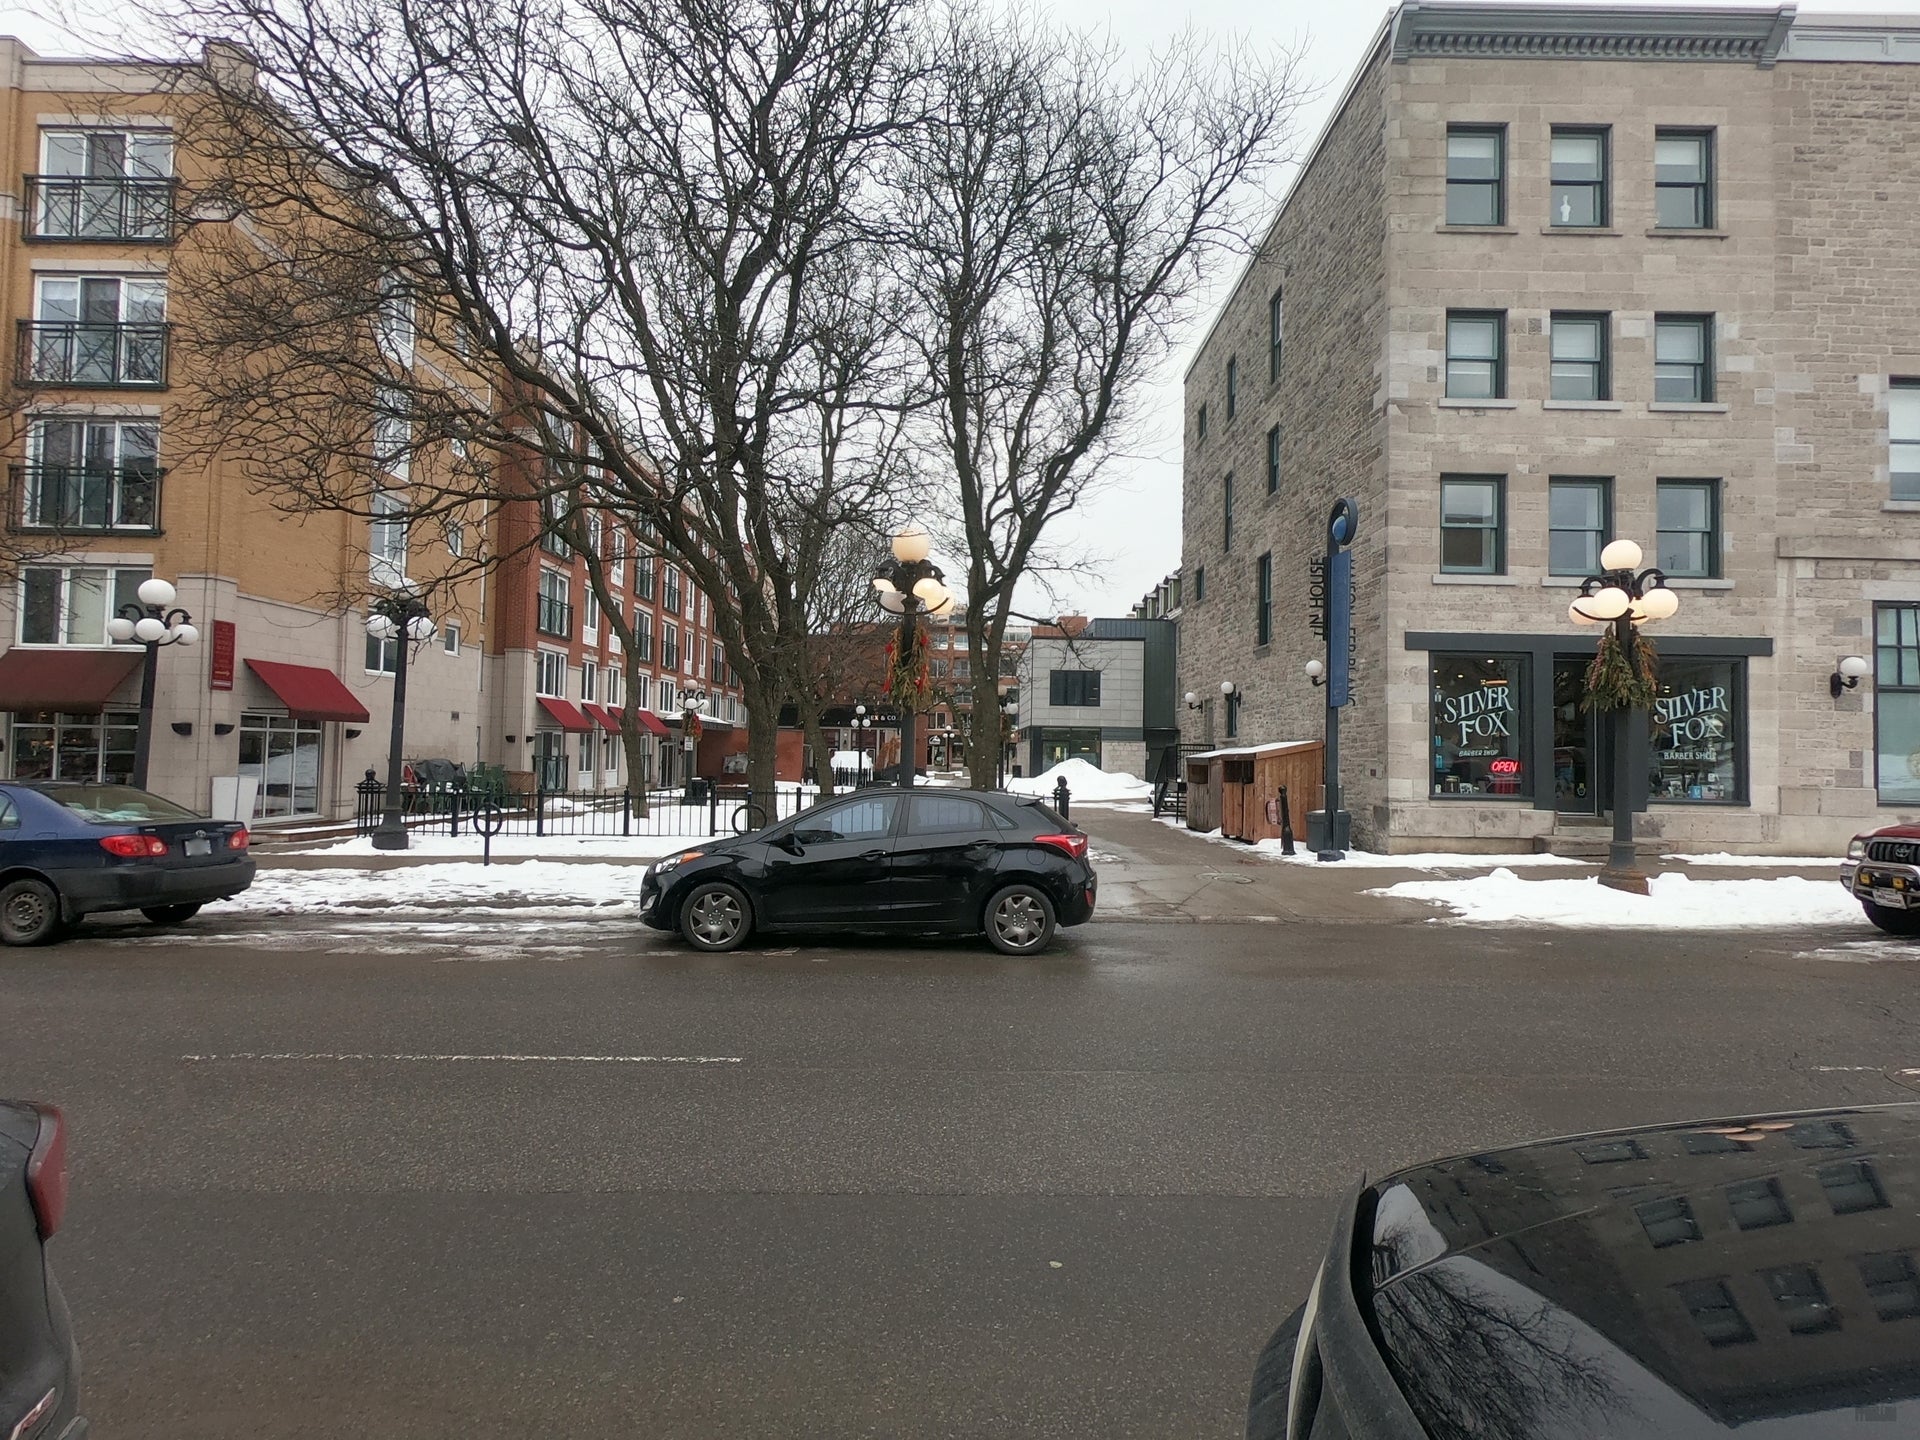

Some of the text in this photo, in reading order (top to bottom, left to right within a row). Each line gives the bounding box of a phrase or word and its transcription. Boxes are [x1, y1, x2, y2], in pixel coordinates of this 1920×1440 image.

[1309, 557, 1325, 608] HOUSE
[1444, 686, 1514, 723] SILVER
[1653, 686, 1729, 724] SILVER
[1457, 710, 1511, 748] FOX
[1669, 713, 1726, 749] FOX
[1491, 761, 1519, 773] OPEN
[1663, 751, 1717, 761] BARBER SHOP
